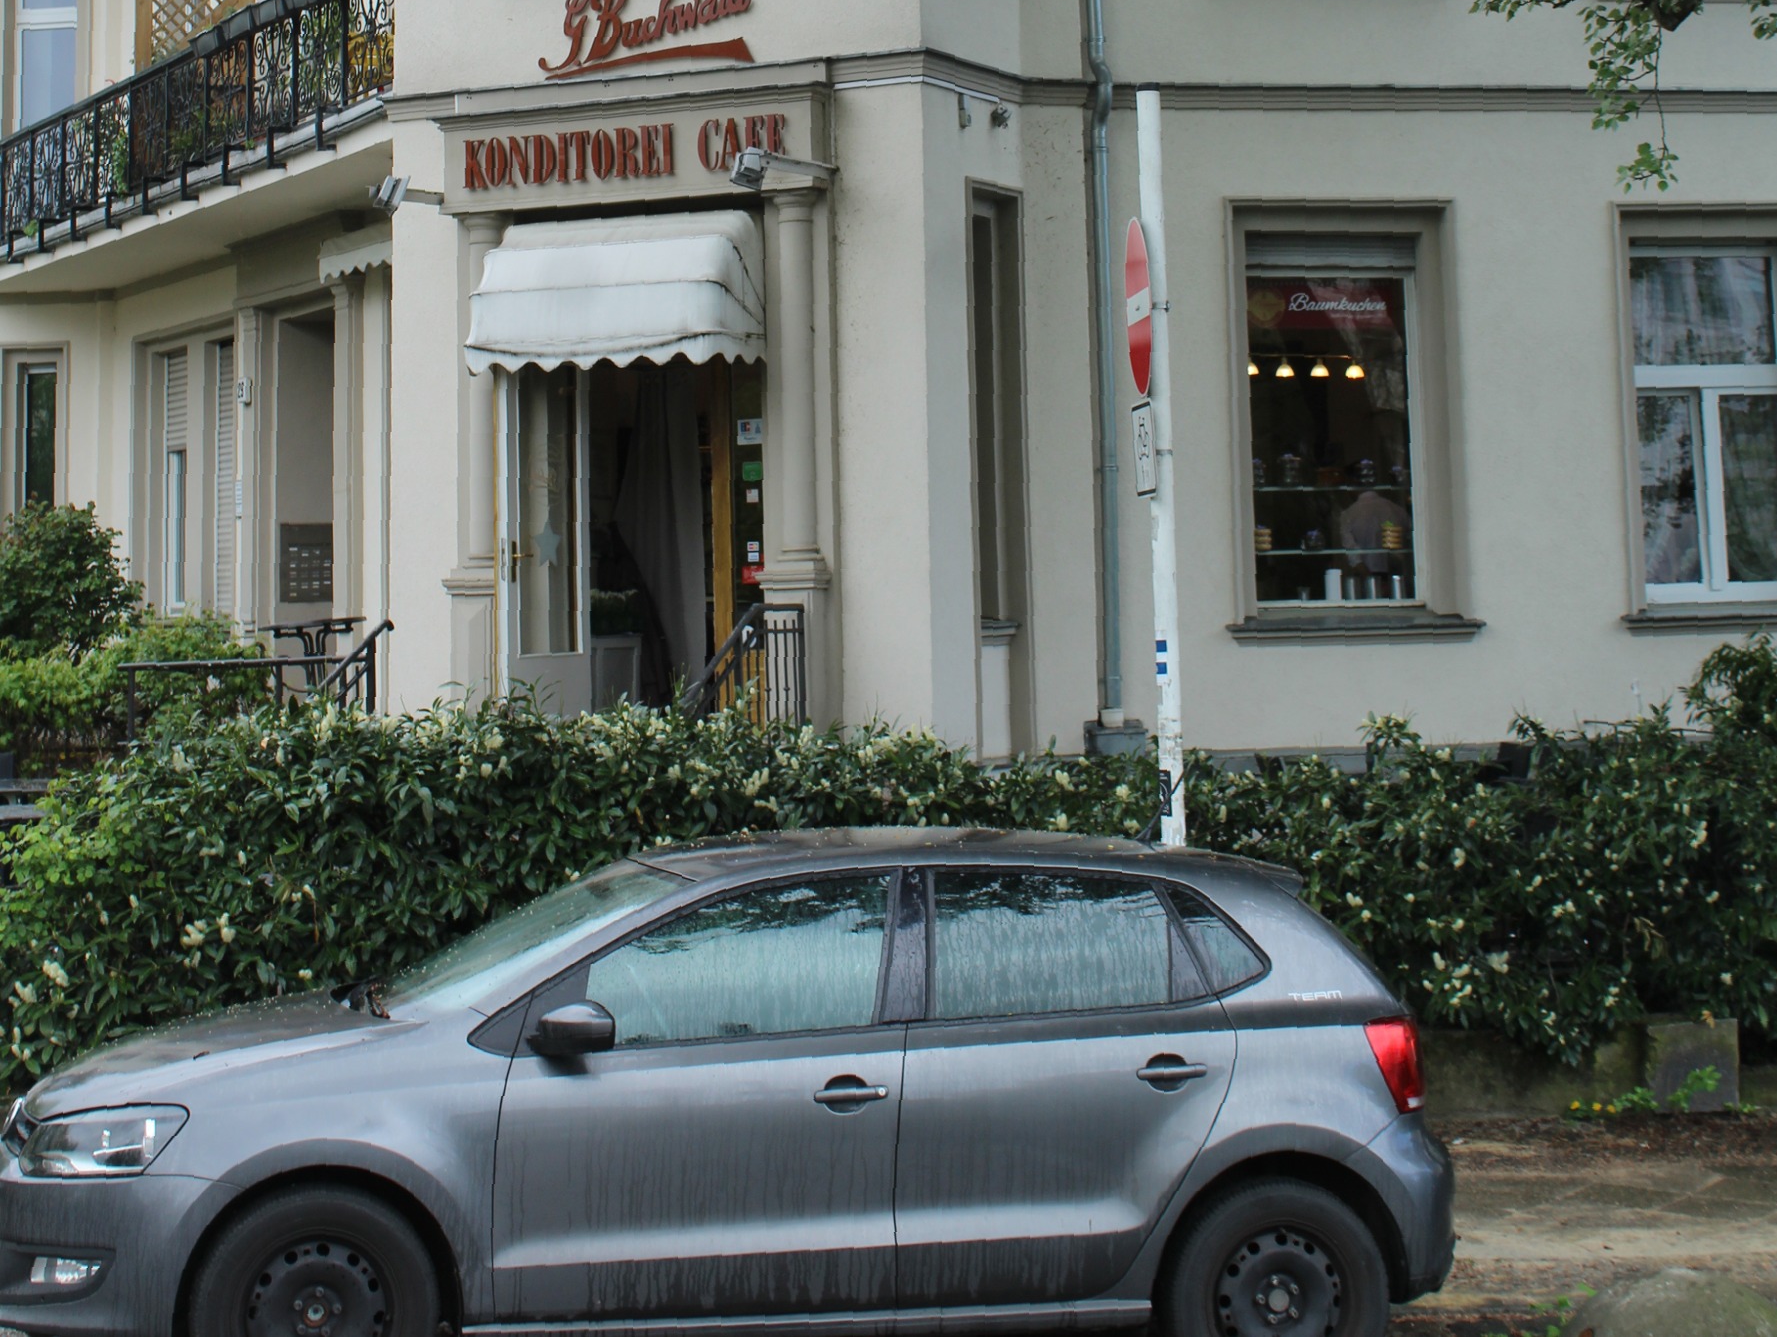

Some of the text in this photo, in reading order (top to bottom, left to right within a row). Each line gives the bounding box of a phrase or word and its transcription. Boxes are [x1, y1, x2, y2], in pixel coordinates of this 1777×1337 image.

[463, 113, 786, 191] KONDITOREI CAFE
[1288, 292, 1387, 312] Baumkuchen
[1287, 989, 1343, 1001] TEAM
